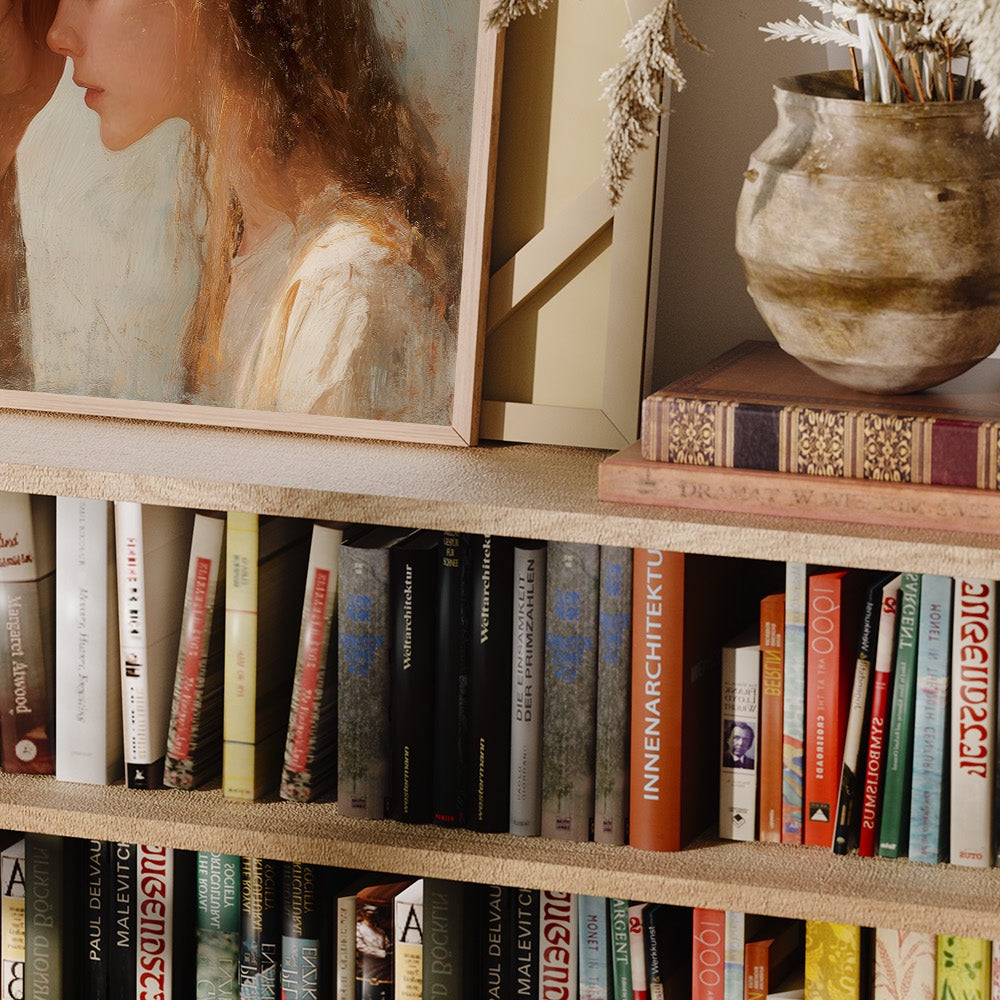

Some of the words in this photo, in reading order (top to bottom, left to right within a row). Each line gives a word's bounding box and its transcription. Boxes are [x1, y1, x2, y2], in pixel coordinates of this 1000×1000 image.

[6, 594, 25, 658] Margaret
[402, 563, 413, 671] Weltarchitektur
[516, 572, 526, 687] EINSAMKEIT
[524, 558, 536, 680] PRIMZAHLEN
[13, 660, 33, 715] Atwood
[516, 691, 525, 722] DIE
[524, 684, 534, 722] DER
[403, 745, 411, 814] westermann
[477, 737, 486, 821] westermann
[89, 840, 102, 910] DELVAU
[89, 917, 101, 961] PAUL
[587, 914, 600, 952] MONET
[647, 926, 660, 974] Werkkunst
[692, 920, 721, 987] 1900
